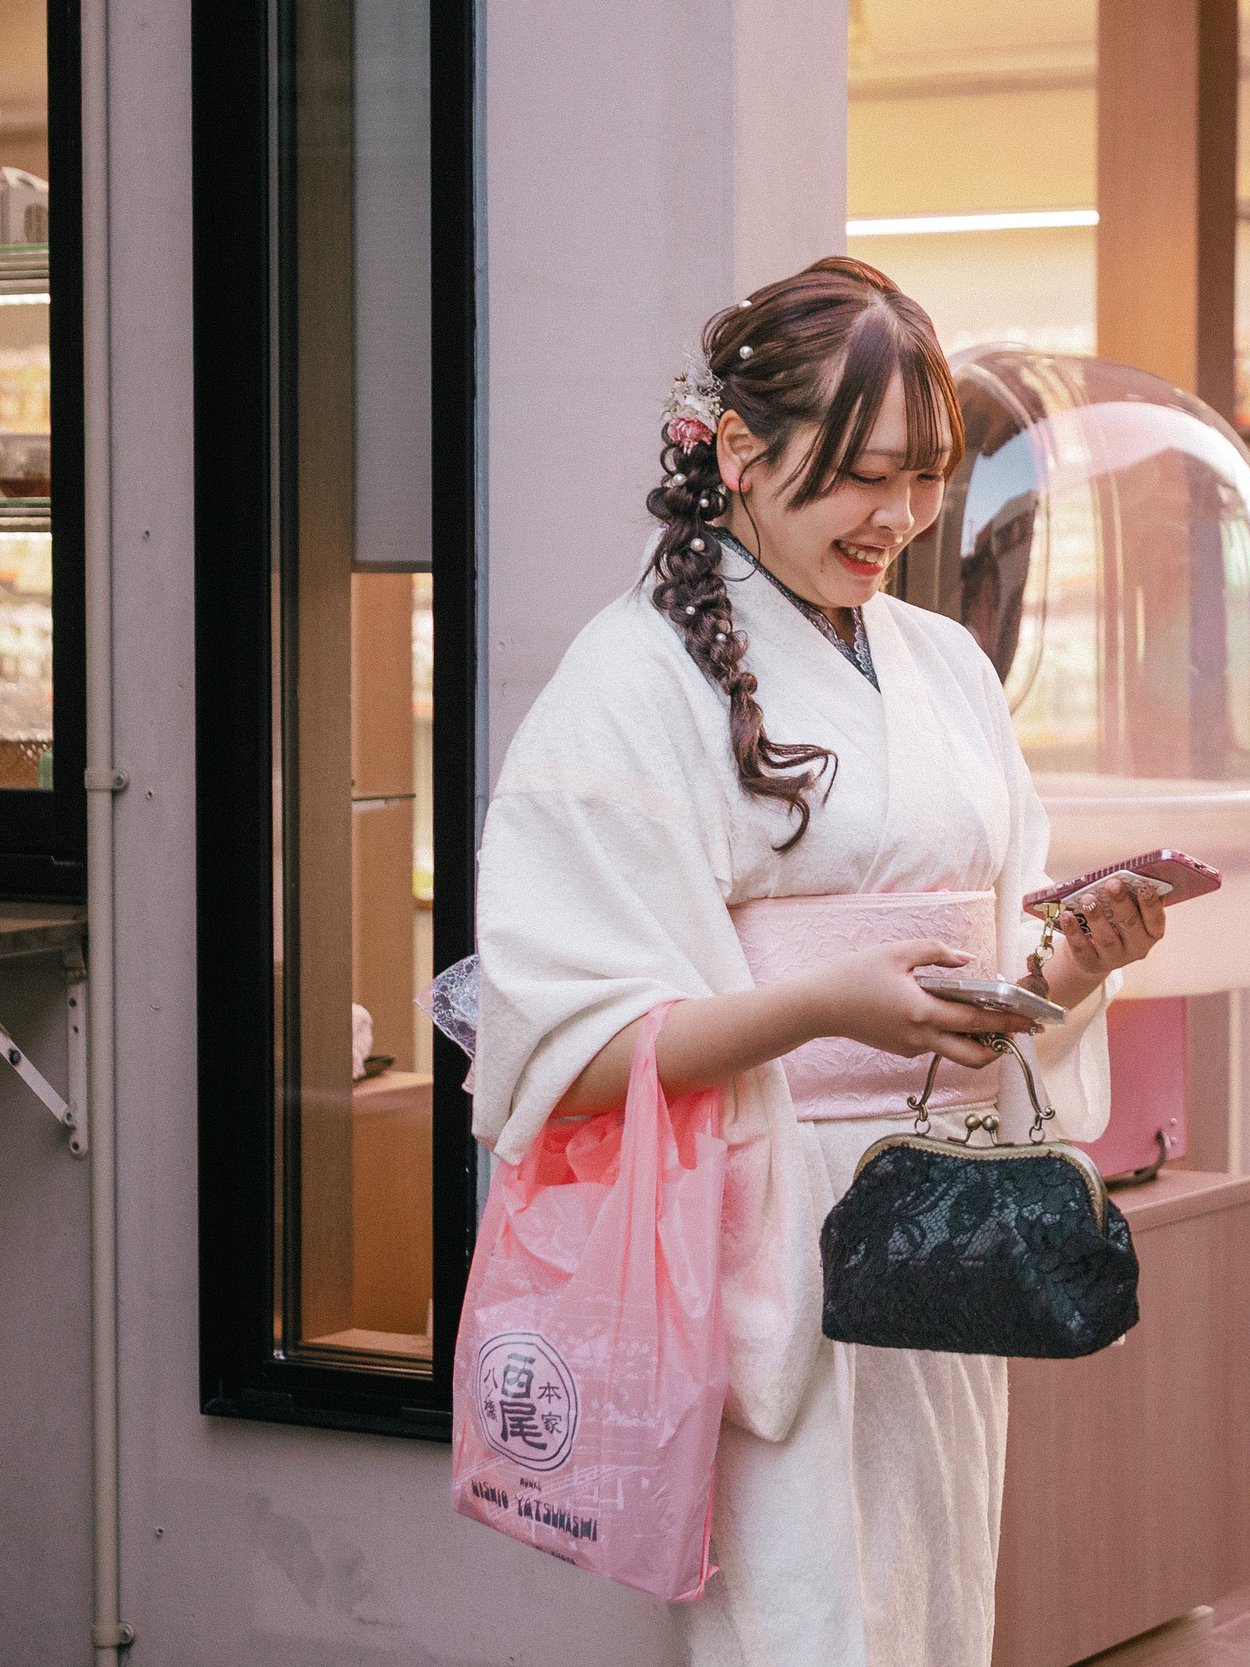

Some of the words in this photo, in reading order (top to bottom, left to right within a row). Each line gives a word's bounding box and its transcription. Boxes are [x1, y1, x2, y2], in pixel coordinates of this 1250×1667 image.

[500, 1353, 547, 1450] 西尾
[538, 1381, 562, 1434] 本家
[471, 1480, 509, 1509] NISHIO
[515, 1493, 598, 1542] YATSUHASHI
